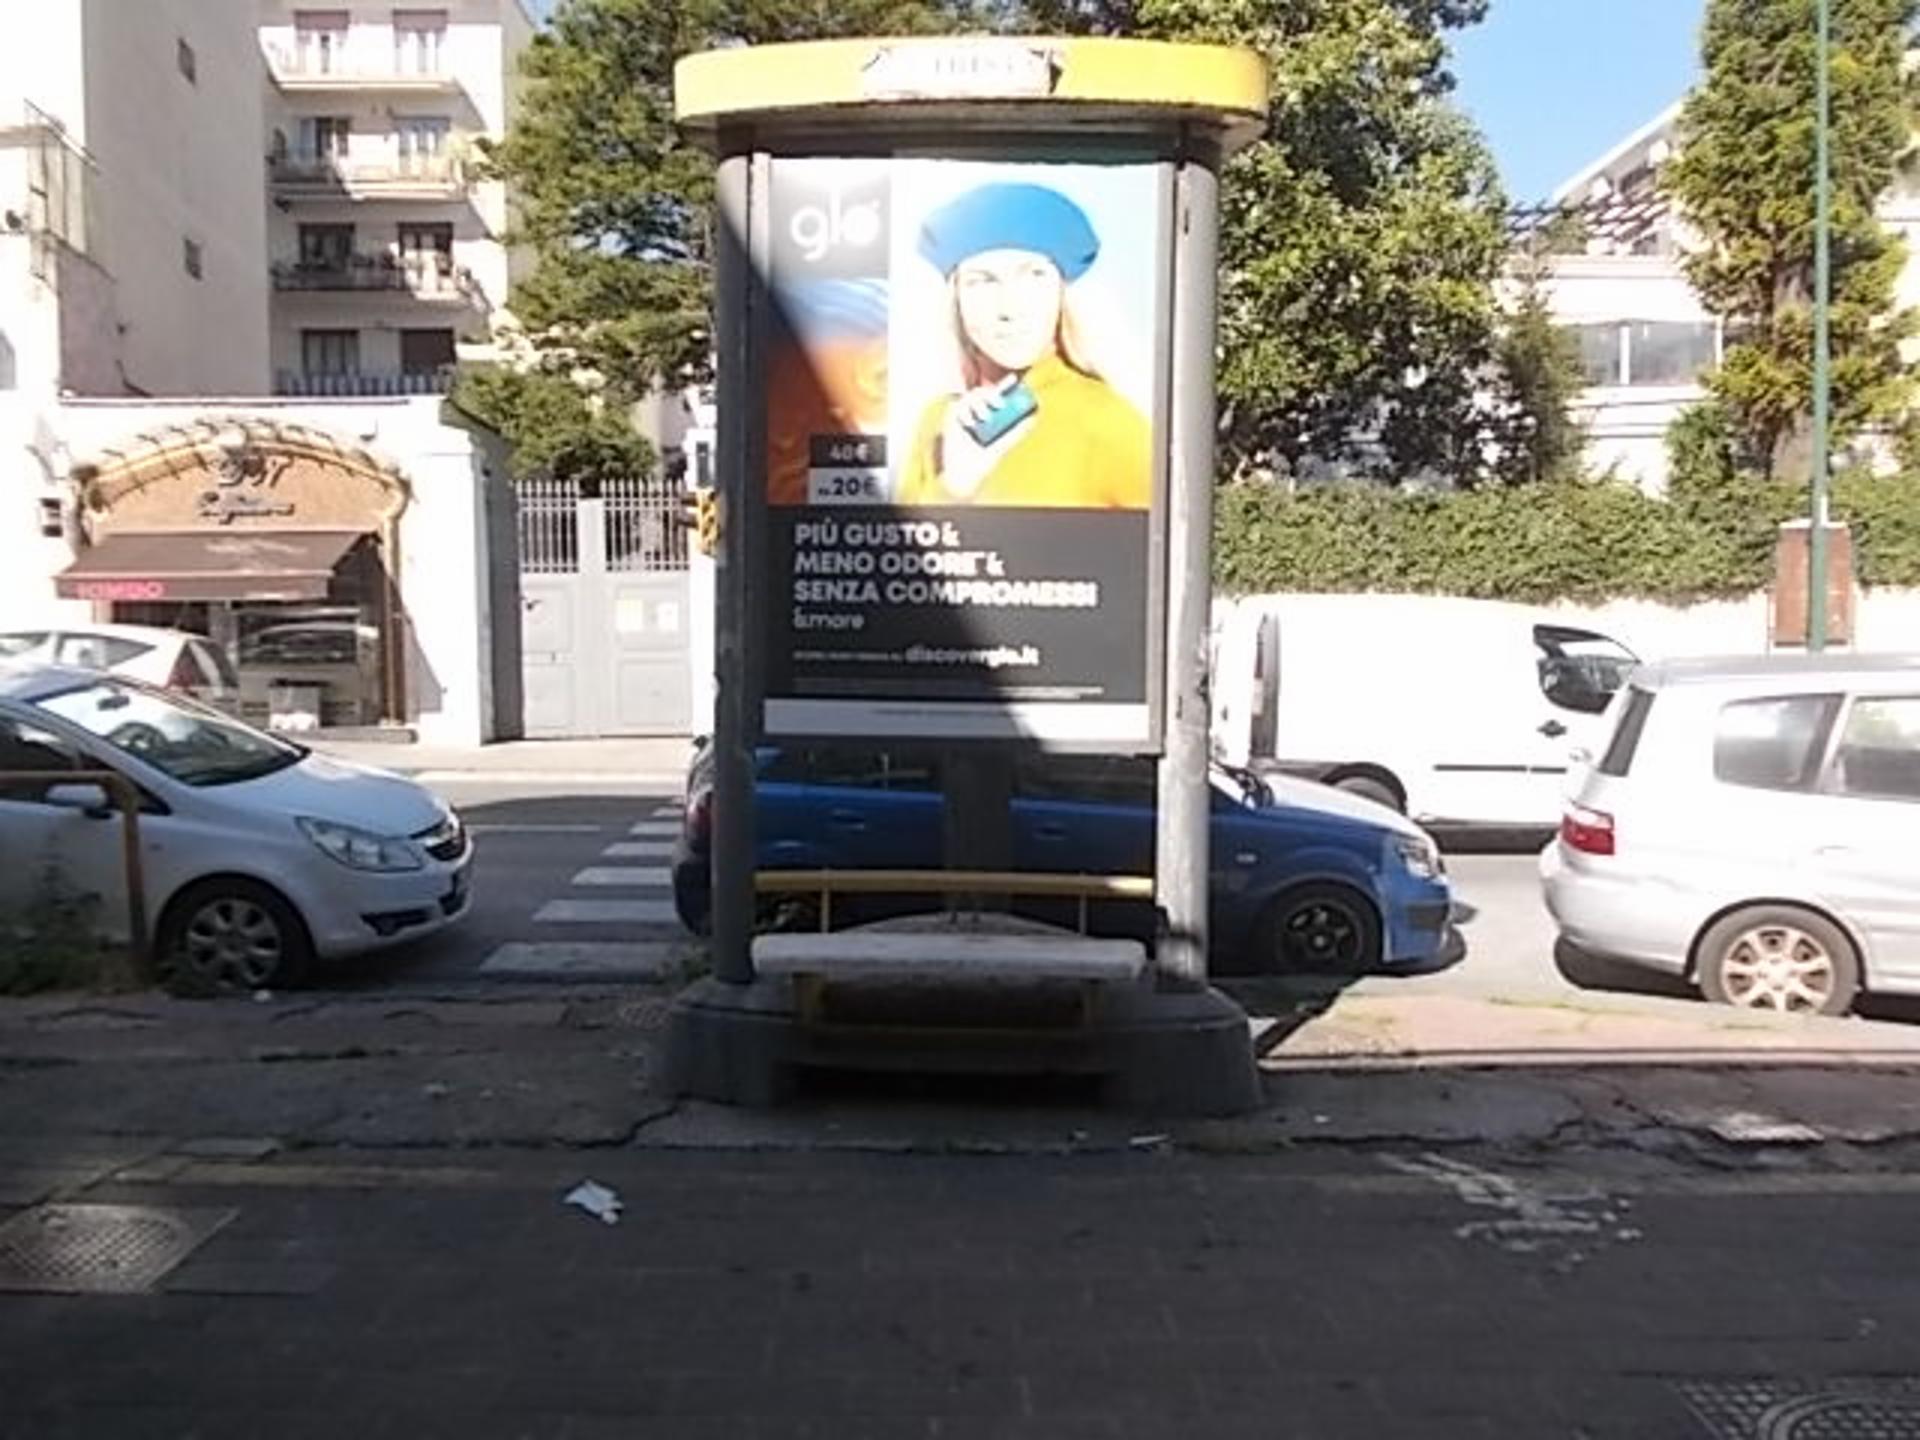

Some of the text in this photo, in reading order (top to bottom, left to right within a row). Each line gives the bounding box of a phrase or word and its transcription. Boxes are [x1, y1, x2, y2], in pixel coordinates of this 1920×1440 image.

[844, 521, 940, 547] GUSTO
[795, 551, 875, 574] MENO
[794, 579, 1098, 607] SENZA COMPROMESSI
